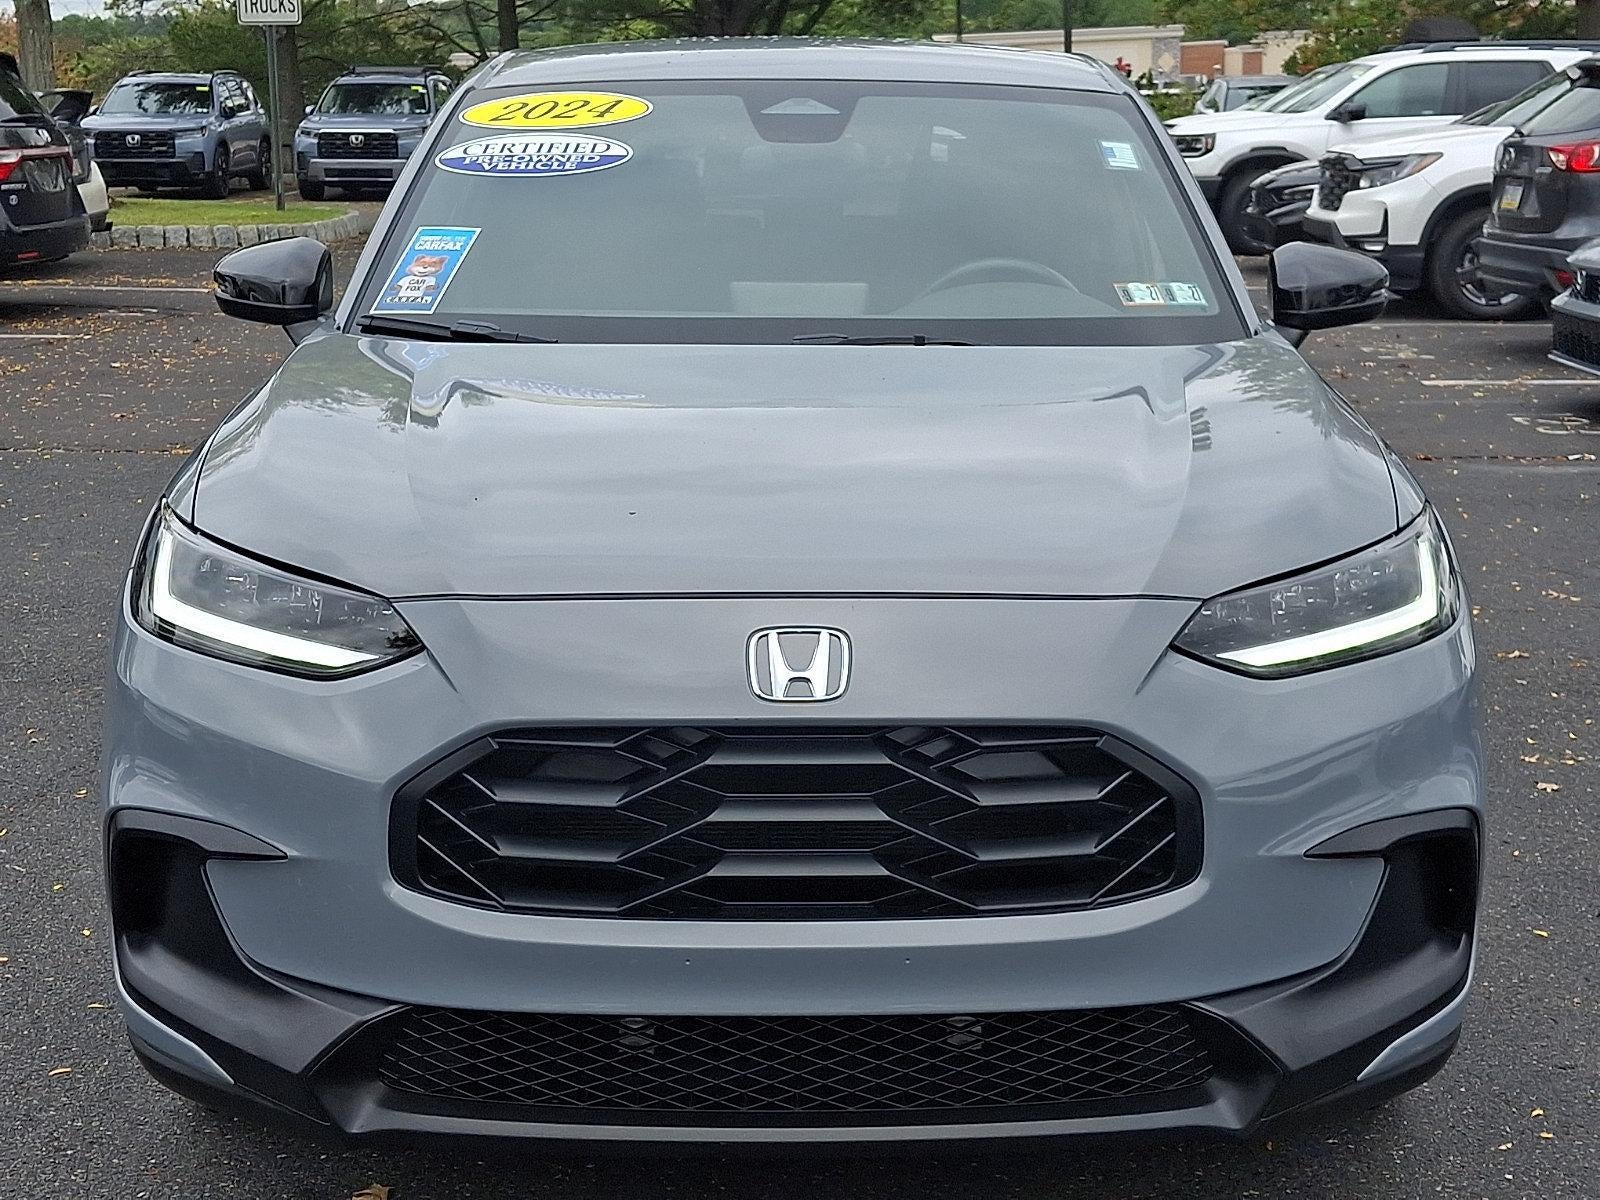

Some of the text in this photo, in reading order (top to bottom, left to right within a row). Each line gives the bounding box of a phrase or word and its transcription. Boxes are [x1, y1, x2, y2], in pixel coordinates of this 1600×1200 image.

[488, 99, 624, 122] 2024
[463, 142, 611, 156] CERTIFIED
[463, 155, 601, 165] PRE-OWNED
[481, 161, 577, 171] VEHICLE
[414, 241, 464, 251] CARFAX
